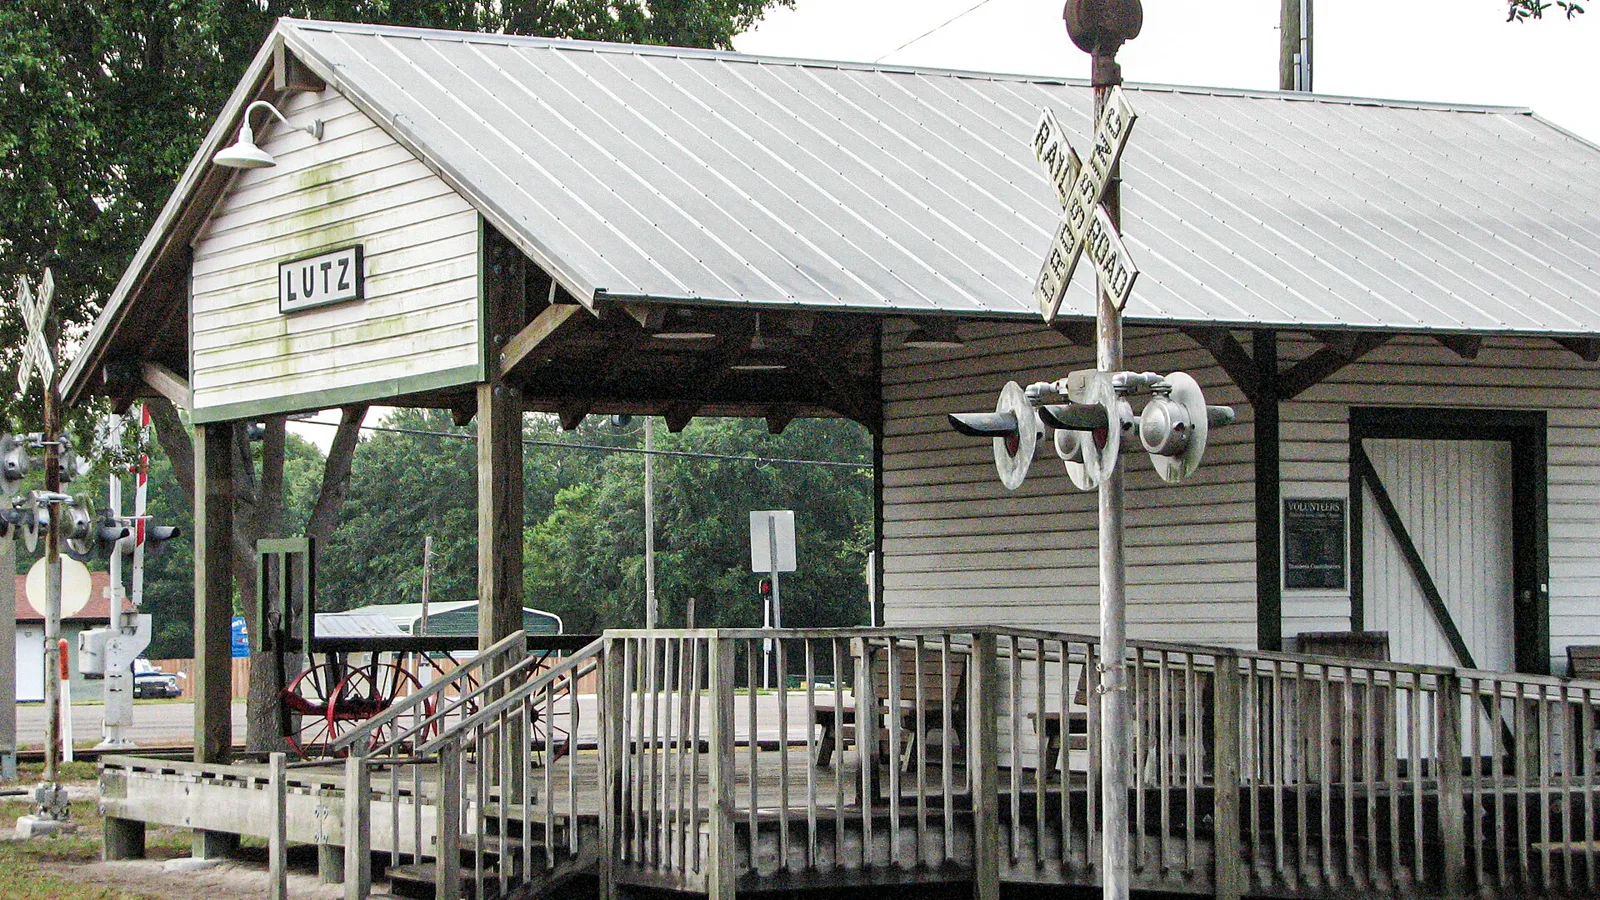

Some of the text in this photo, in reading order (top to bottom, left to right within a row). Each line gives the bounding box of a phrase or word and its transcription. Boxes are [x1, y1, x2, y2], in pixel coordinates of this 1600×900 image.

[1034, 119, 1128, 299] RAIL ROAD
[1039, 107, 1122, 304] CROSSING
[287, 257, 350, 302] LUTZ
[1288, 502, 1340, 512] VOLUNTEERS
